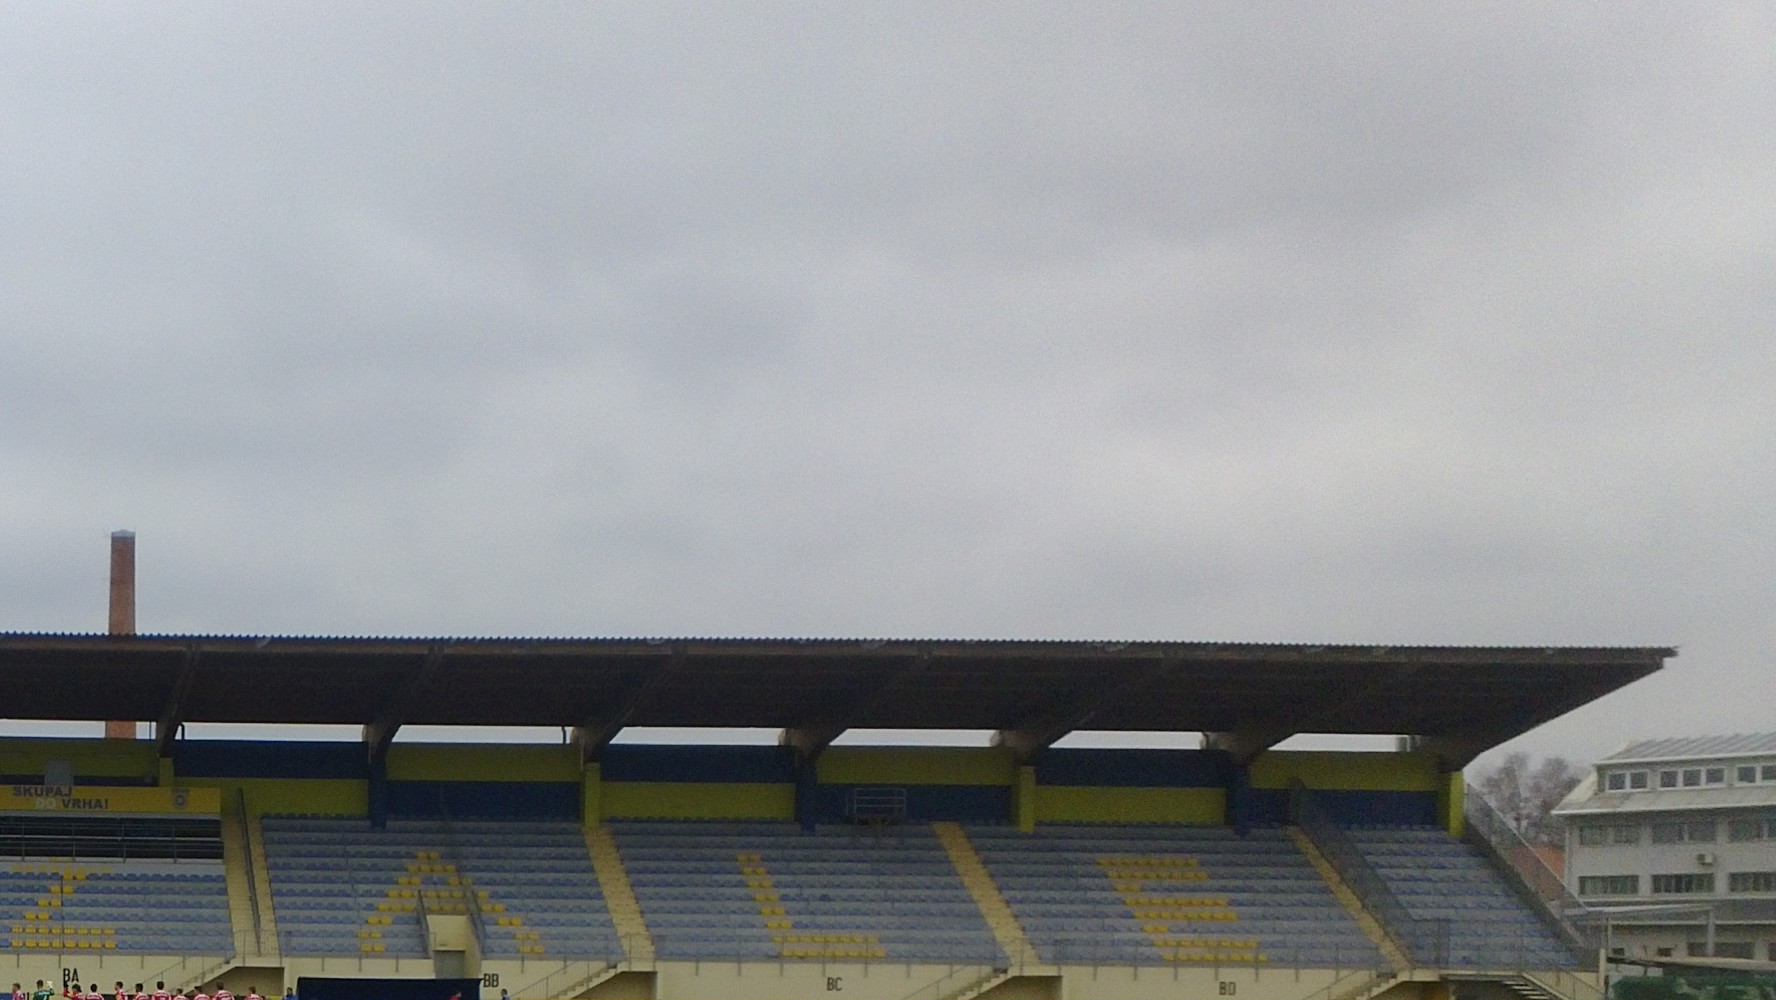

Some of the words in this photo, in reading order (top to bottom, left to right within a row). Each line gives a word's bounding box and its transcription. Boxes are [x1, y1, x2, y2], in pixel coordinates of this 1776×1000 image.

[12, 785, 73, 797] SKUPAJ
[62, 798, 109, 809] VRHA!
[62, 968, 79, 982] BA
[483, 973, 499, 988] BB
[826, 977, 843, 991] BC
